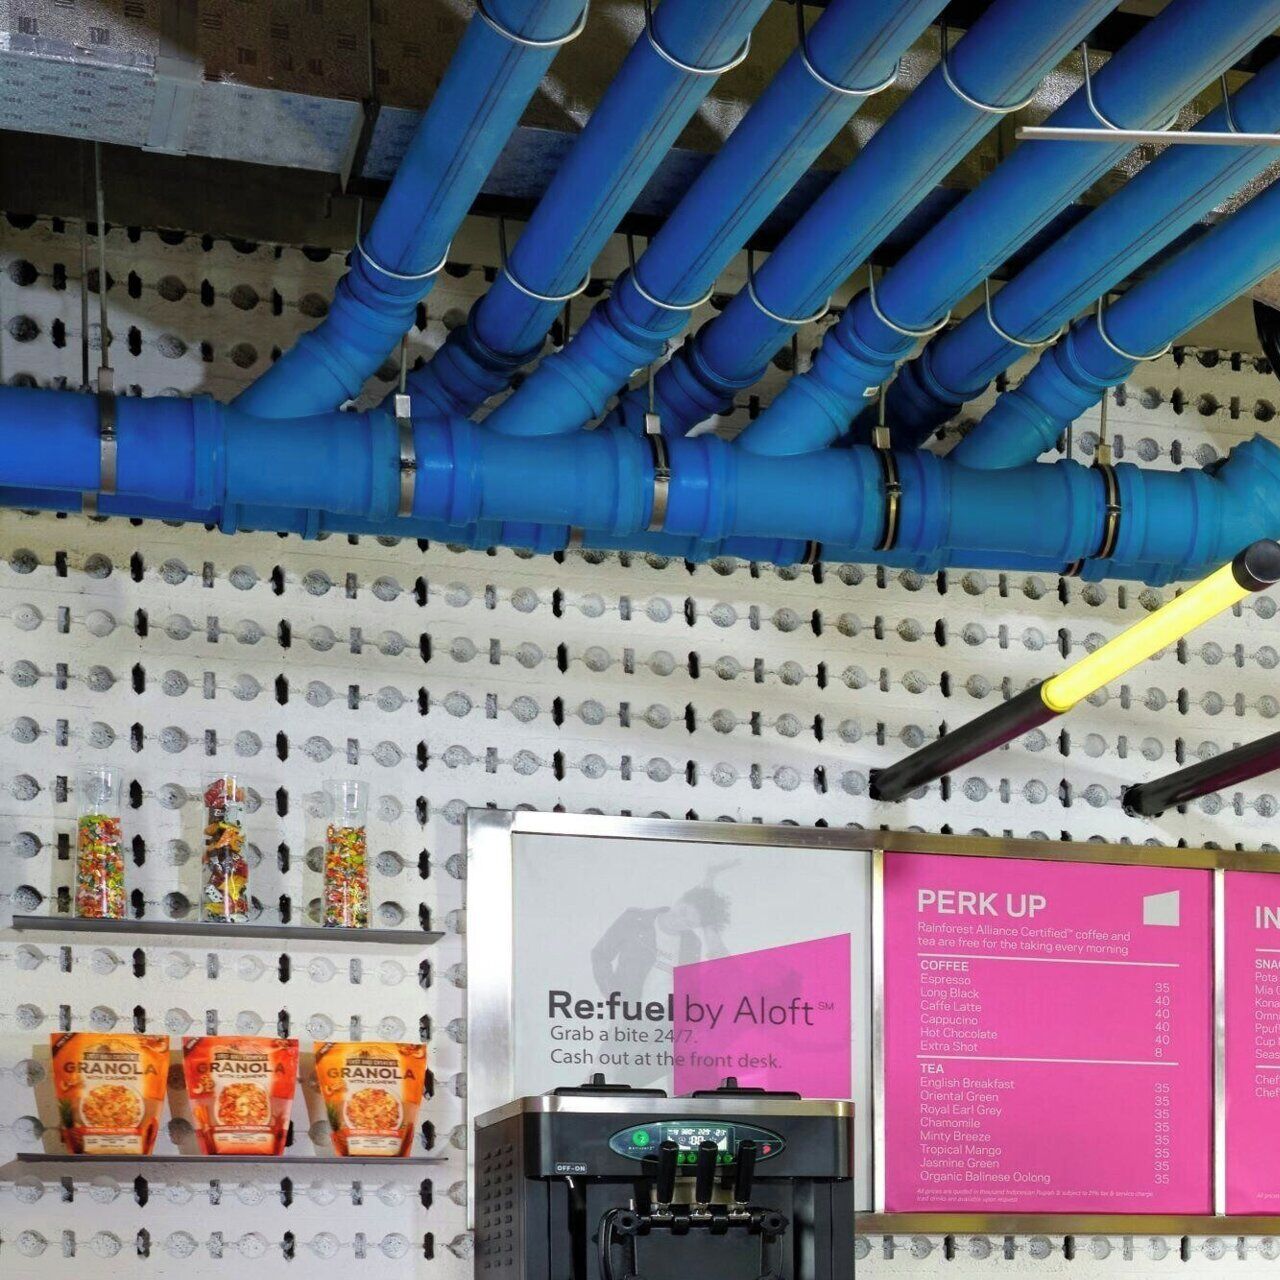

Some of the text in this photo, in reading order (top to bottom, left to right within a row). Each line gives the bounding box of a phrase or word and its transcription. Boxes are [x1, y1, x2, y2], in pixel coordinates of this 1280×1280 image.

[919, 889, 1046, 917] PERK UP
[1256, 906, 1280, 929] IN
[918, 922, 973, 934] Rainforest
[976, 925, 1018, 936] Alliance
[1076, 929, 1108, 940] coffee
[1111, 932, 1130, 941] and
[918, 937, 1128, 956] tea are free for the taking every morning
[921, 960, 968, 971] COFFEE
[921, 973, 1169, 993] Espresso 35
[921, 988, 1170, 1005] Long Black 40
[1255, 985, 1273, 995] Mia
[549, 990, 674, 1021] Re:fuel
[685, 994, 725, 1029] by
[734, 996, 814, 1026] Aloft
[1255, 998, 1280, 1008] Kona
[954, 1002, 981, 1012] Latte
[1155, 1009, 1169, 1018] 40
[1255, 1011, 1280, 1020] Omni
[921, 1014, 1169, 1031] Cappucino 40
[550, 1026, 698, 1044] Grab a bite 24/7.
[921, 1027, 1169, 1045] Hot Chocolate 40
[921, 1040, 1162, 1057] Extra Shot 8
[1256, 1036, 1275, 1048] Cup
[550, 1049, 782, 1069] Cash out at the front desk.
[64, 1062, 157, 1075] GRANOLA
[197, 1062, 286, 1073] GRANOLA
[327, 1068, 416, 1080] GRANOLA
[920, 1063, 944, 1073] TEA
[921, 1077, 1014, 1089] English Breakfast
[921, 1090, 998, 1101] Oriental Green
[921, 1104, 1001, 1116] Royal Earl Grey
[920, 1117, 980, 1128] Chamomile
[920, 1130, 991, 1142] Minty Breeze
[920, 1144, 1001, 1157] Tropical Mango
[920, 1158, 999, 1168] Jasmine Green
[920, 1171, 1050, 1184] Organic Balinese Oolong
